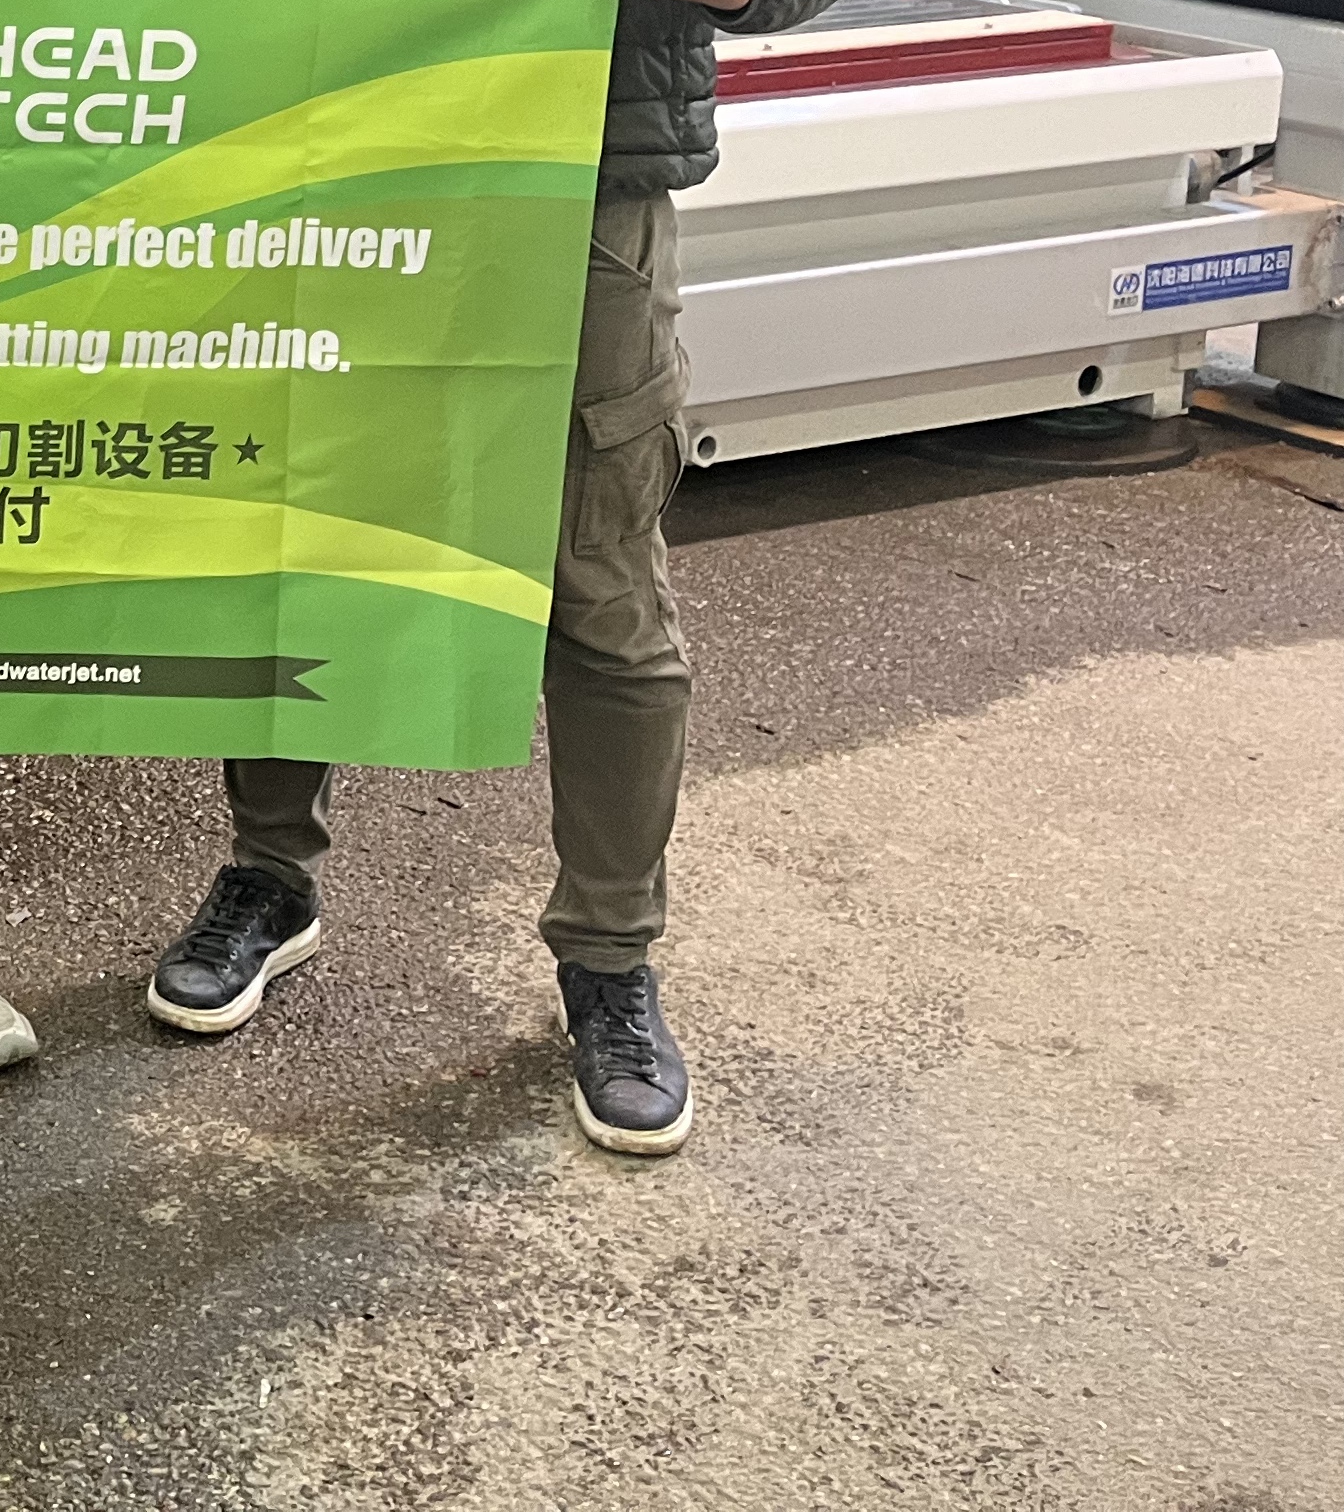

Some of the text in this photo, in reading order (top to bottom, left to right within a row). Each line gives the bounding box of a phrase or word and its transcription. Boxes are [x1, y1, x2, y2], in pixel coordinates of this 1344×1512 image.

[29, 217, 216, 270] perfect
[225, 217, 432, 275] delivery
[119, 322, 351, 373] machine.
